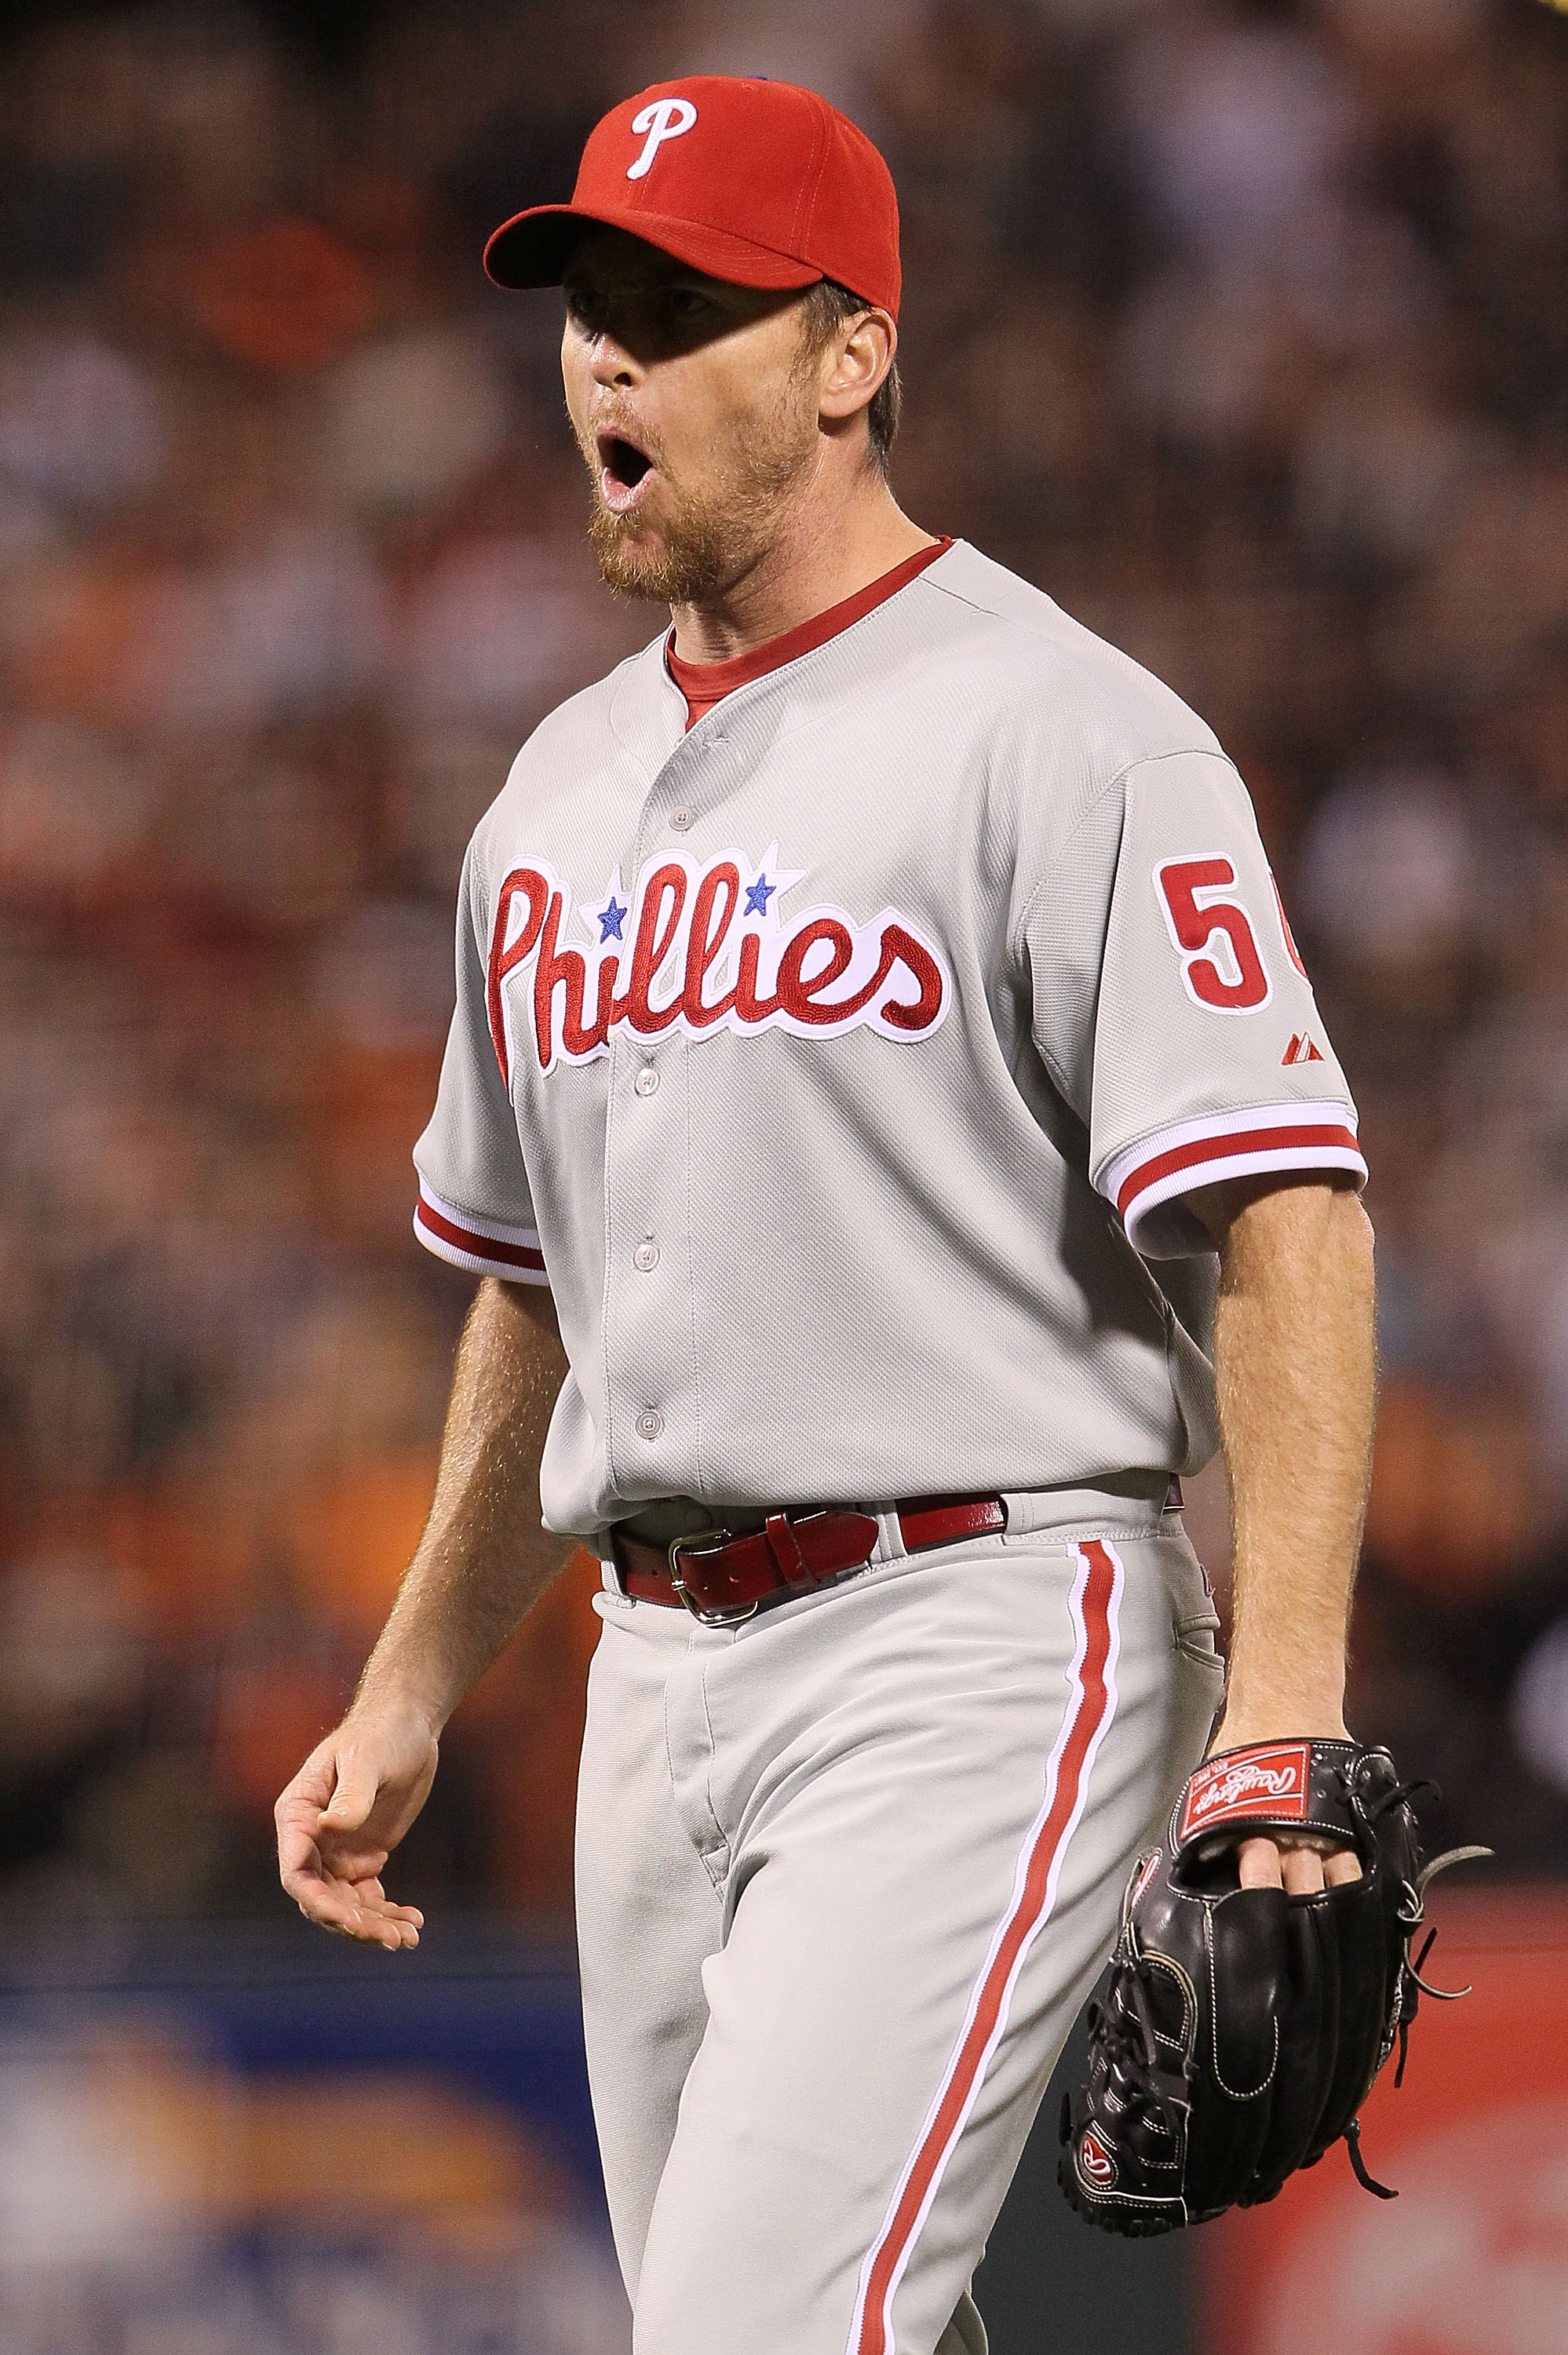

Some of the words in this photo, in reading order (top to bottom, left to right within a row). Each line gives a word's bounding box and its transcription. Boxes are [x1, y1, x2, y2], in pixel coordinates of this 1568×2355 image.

[626, 98, 698, 181] P
[486, 859, 945, 1097] Phillies
[1153, 853, 1311, 1014] 5
[1193, 1765, 1297, 1815] Rawlings
